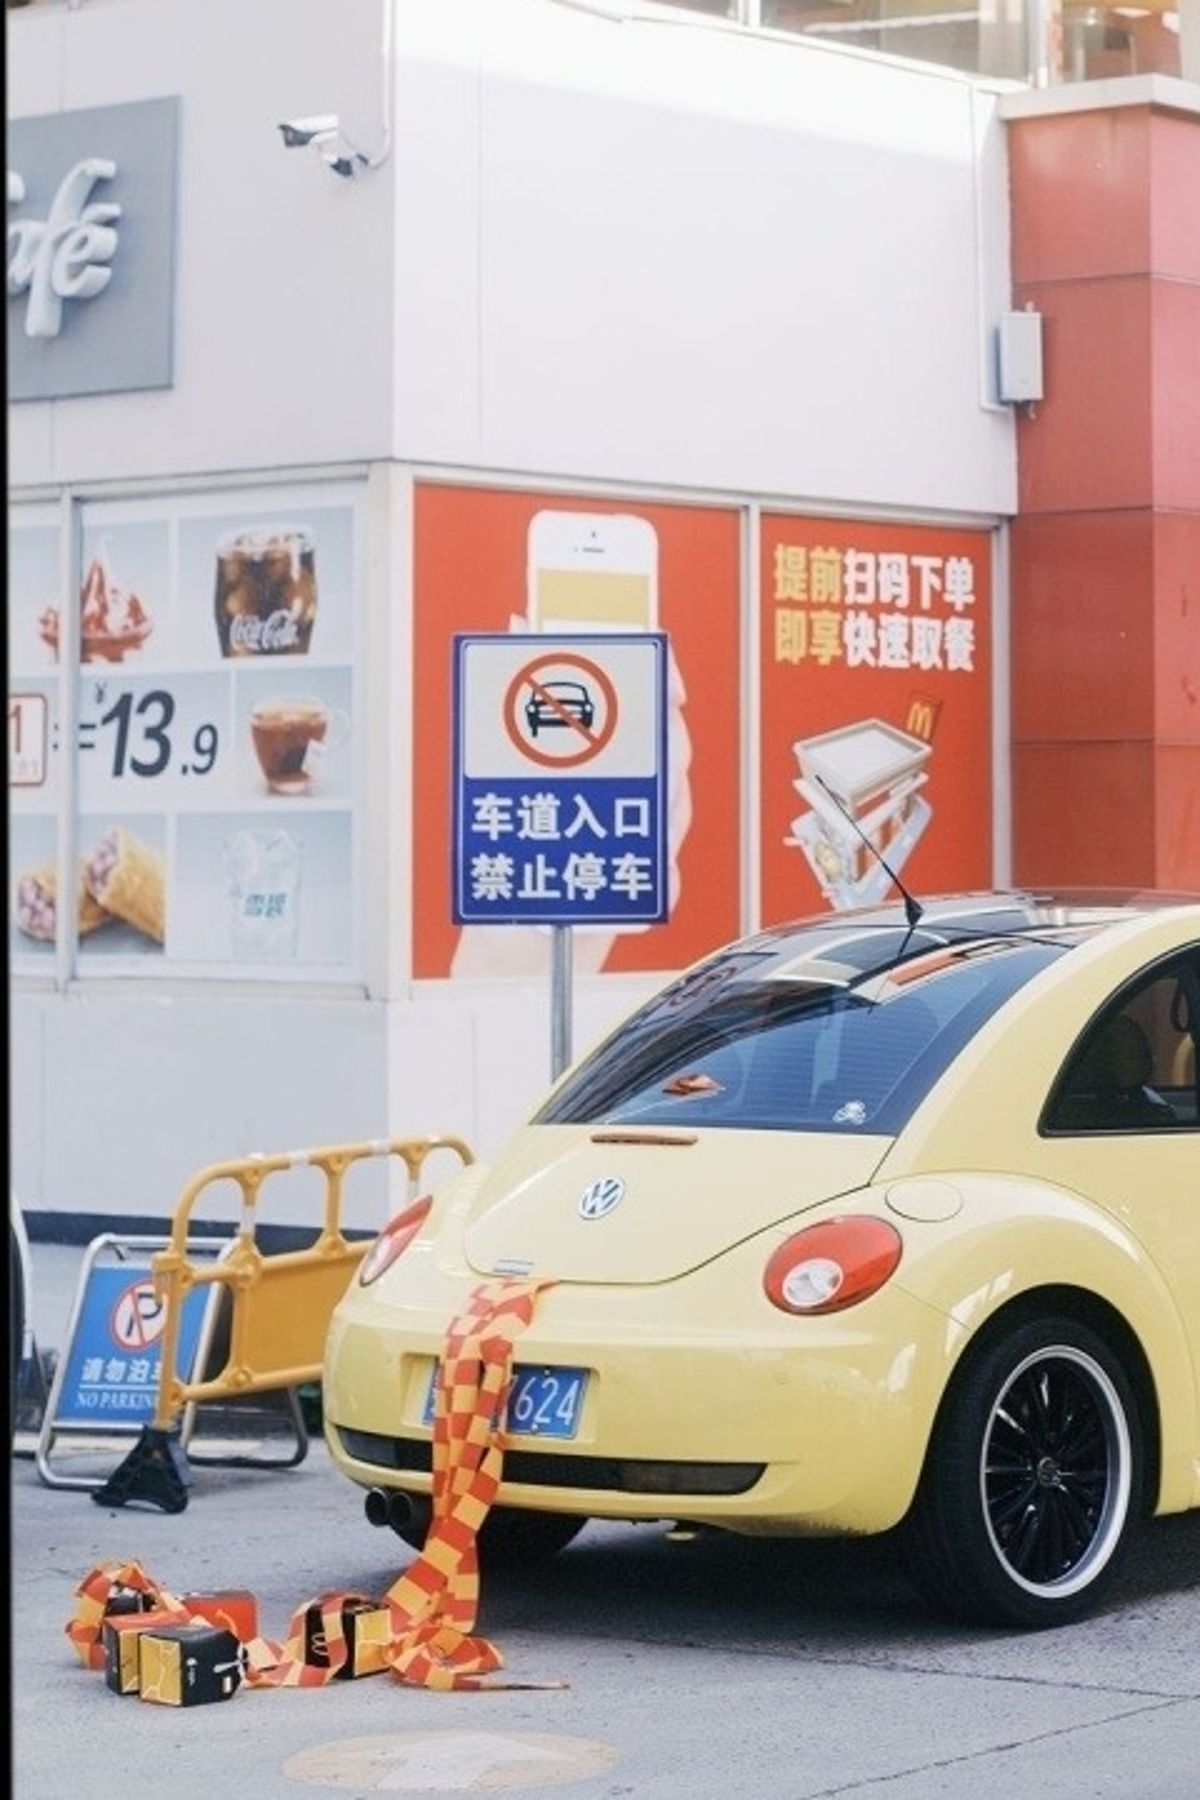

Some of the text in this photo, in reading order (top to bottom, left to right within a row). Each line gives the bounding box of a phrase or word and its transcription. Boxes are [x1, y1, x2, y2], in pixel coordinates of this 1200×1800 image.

[7, 157, 122, 338] afé
[774, 543, 976, 612] 提前扫码下单
[774, 608, 976, 672] 即享快速取餐
[471, 792, 650, 841] 车道入口
[470, 852, 654, 901] 禁止停车
[75, 1391, 158, 1411] NO PARKIN
